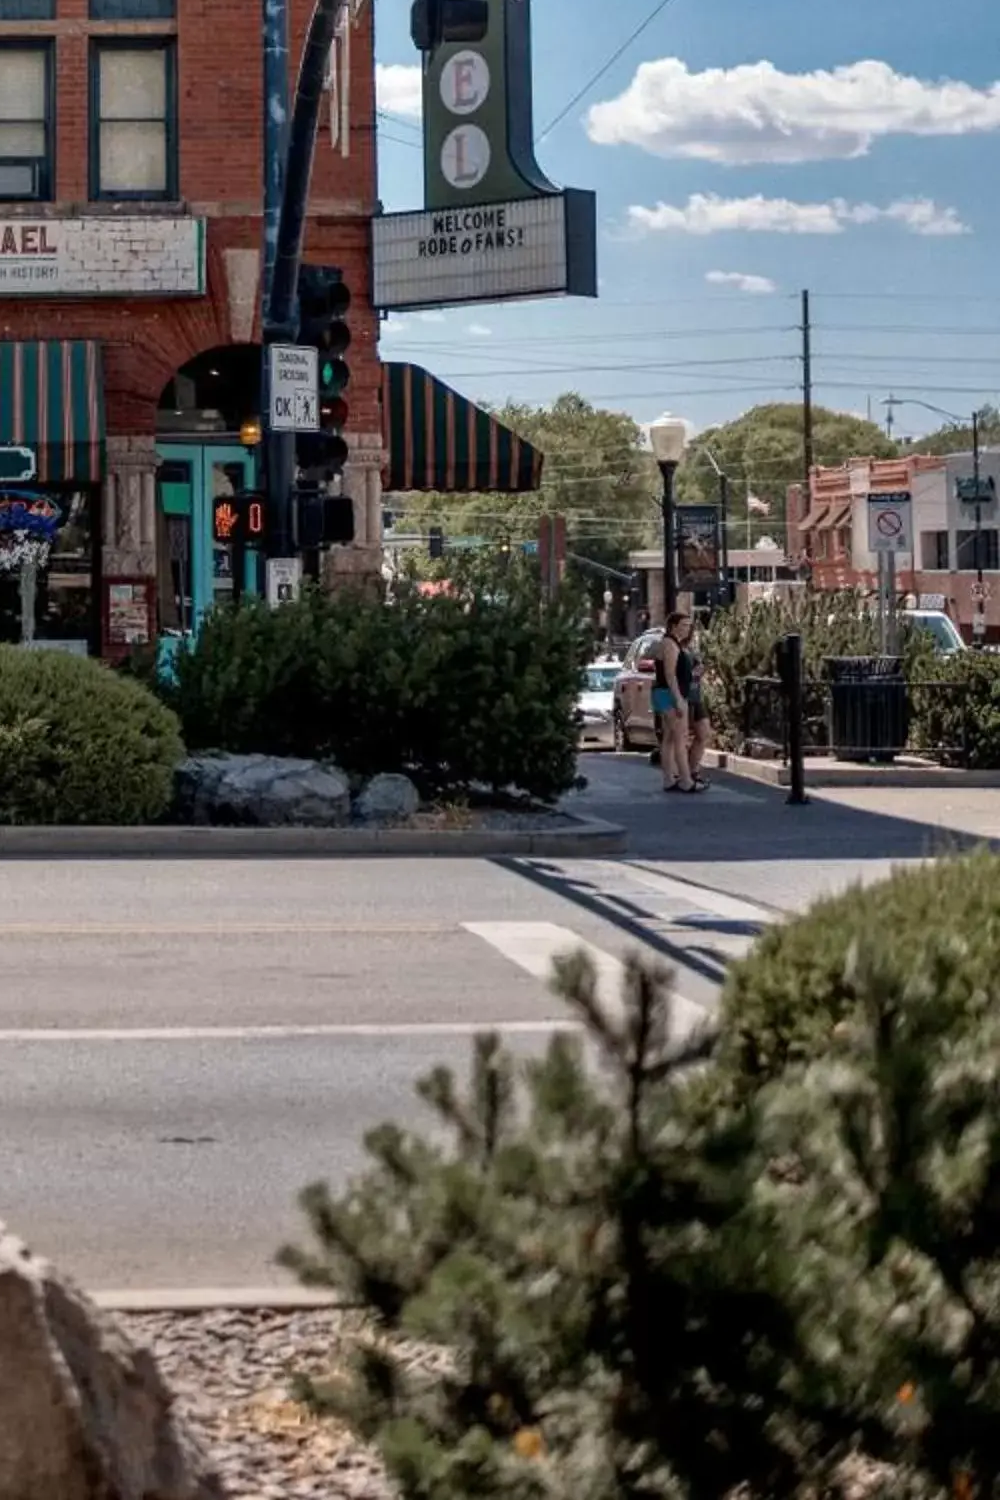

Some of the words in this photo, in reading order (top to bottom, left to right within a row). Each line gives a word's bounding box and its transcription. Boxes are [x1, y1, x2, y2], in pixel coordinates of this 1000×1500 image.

[433, 209, 505, 234] WELCOME
[475, 228, 524, 250] FANS!
[275, 396, 293, 418] OK
